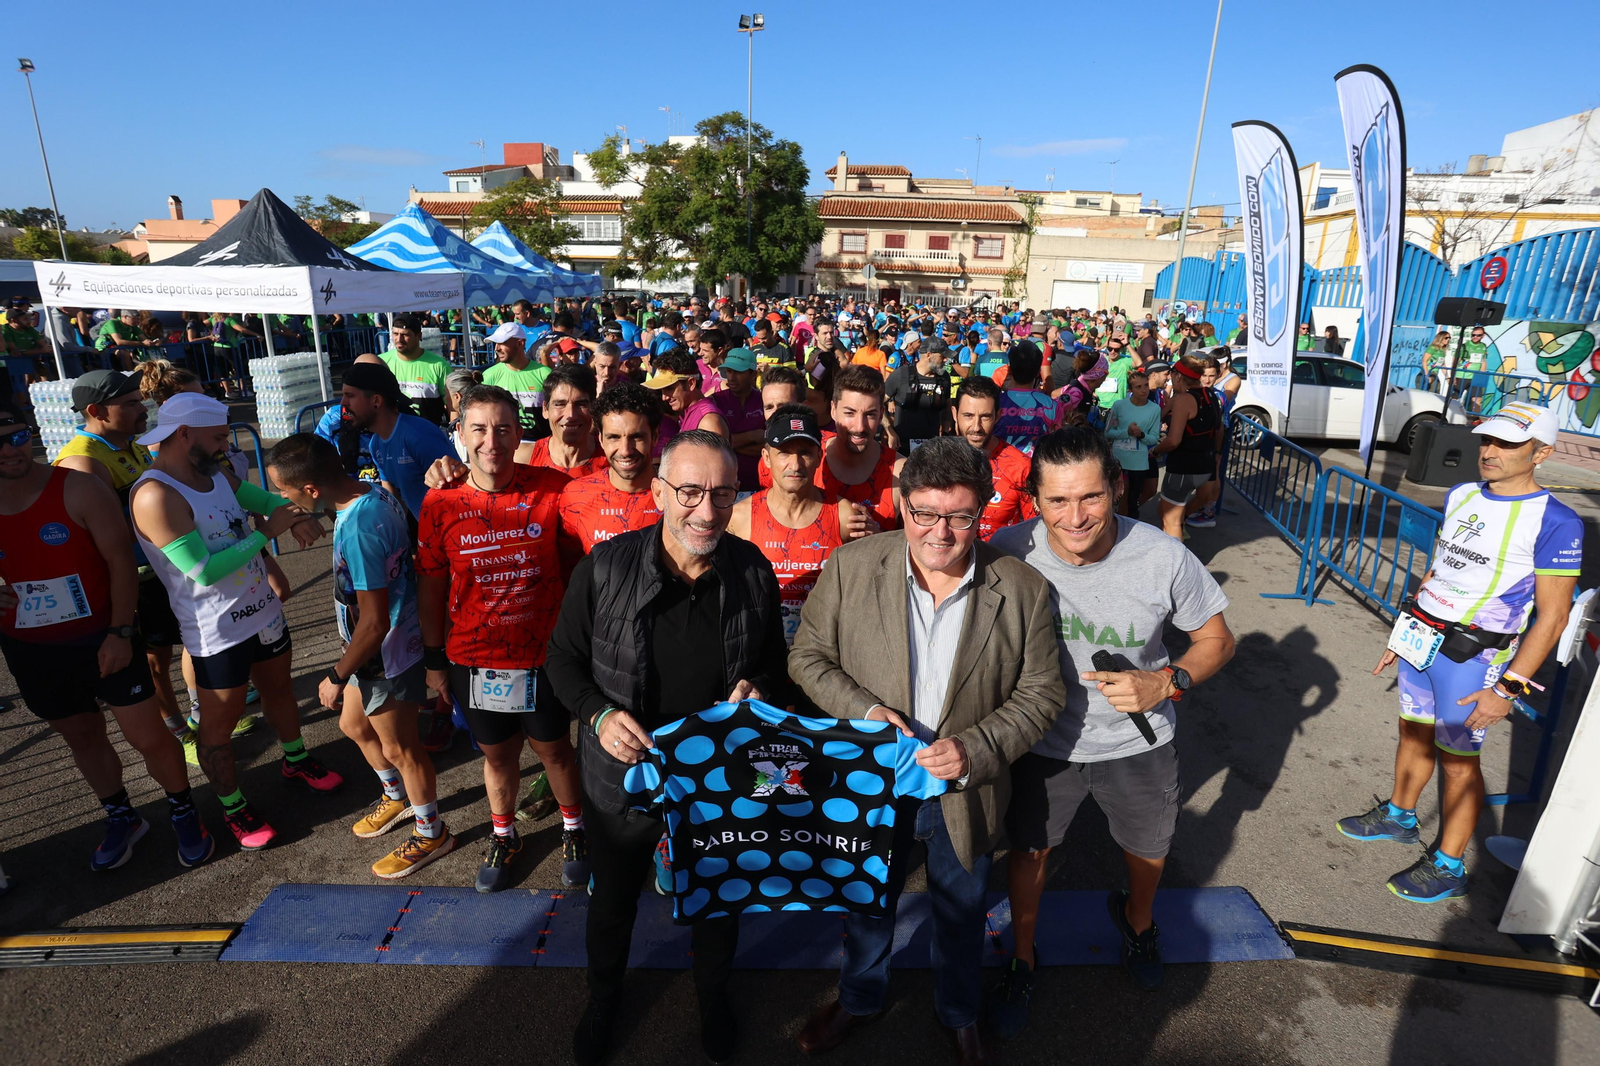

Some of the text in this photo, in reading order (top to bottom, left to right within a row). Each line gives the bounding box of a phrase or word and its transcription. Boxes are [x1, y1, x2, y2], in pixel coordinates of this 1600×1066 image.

[83, 280, 298, 298] Equipaciones deportivas personalizadas
[1006, 425, 1040, 435] TRIPLE
[459, 509, 482, 520] GOBIK
[601, 508, 623, 516] GOBIK
[43, 532, 67, 541] GADIRA
[460, 527, 525, 546] Movijerez
[771, 559, 819, 571] ovijerez
[493, 566, 541, 582] FITNESS
[24, 594, 58, 612] 675
[68, 578, 88, 614] PIRATILLA
[230, 599, 265, 623] PABLO
[1400, 629, 1423, 651] 510
[482, 682, 514, 697] 567
[769, 744, 802, 754] TRAIL
[692, 829, 872, 853] PABLO SONRÍE
